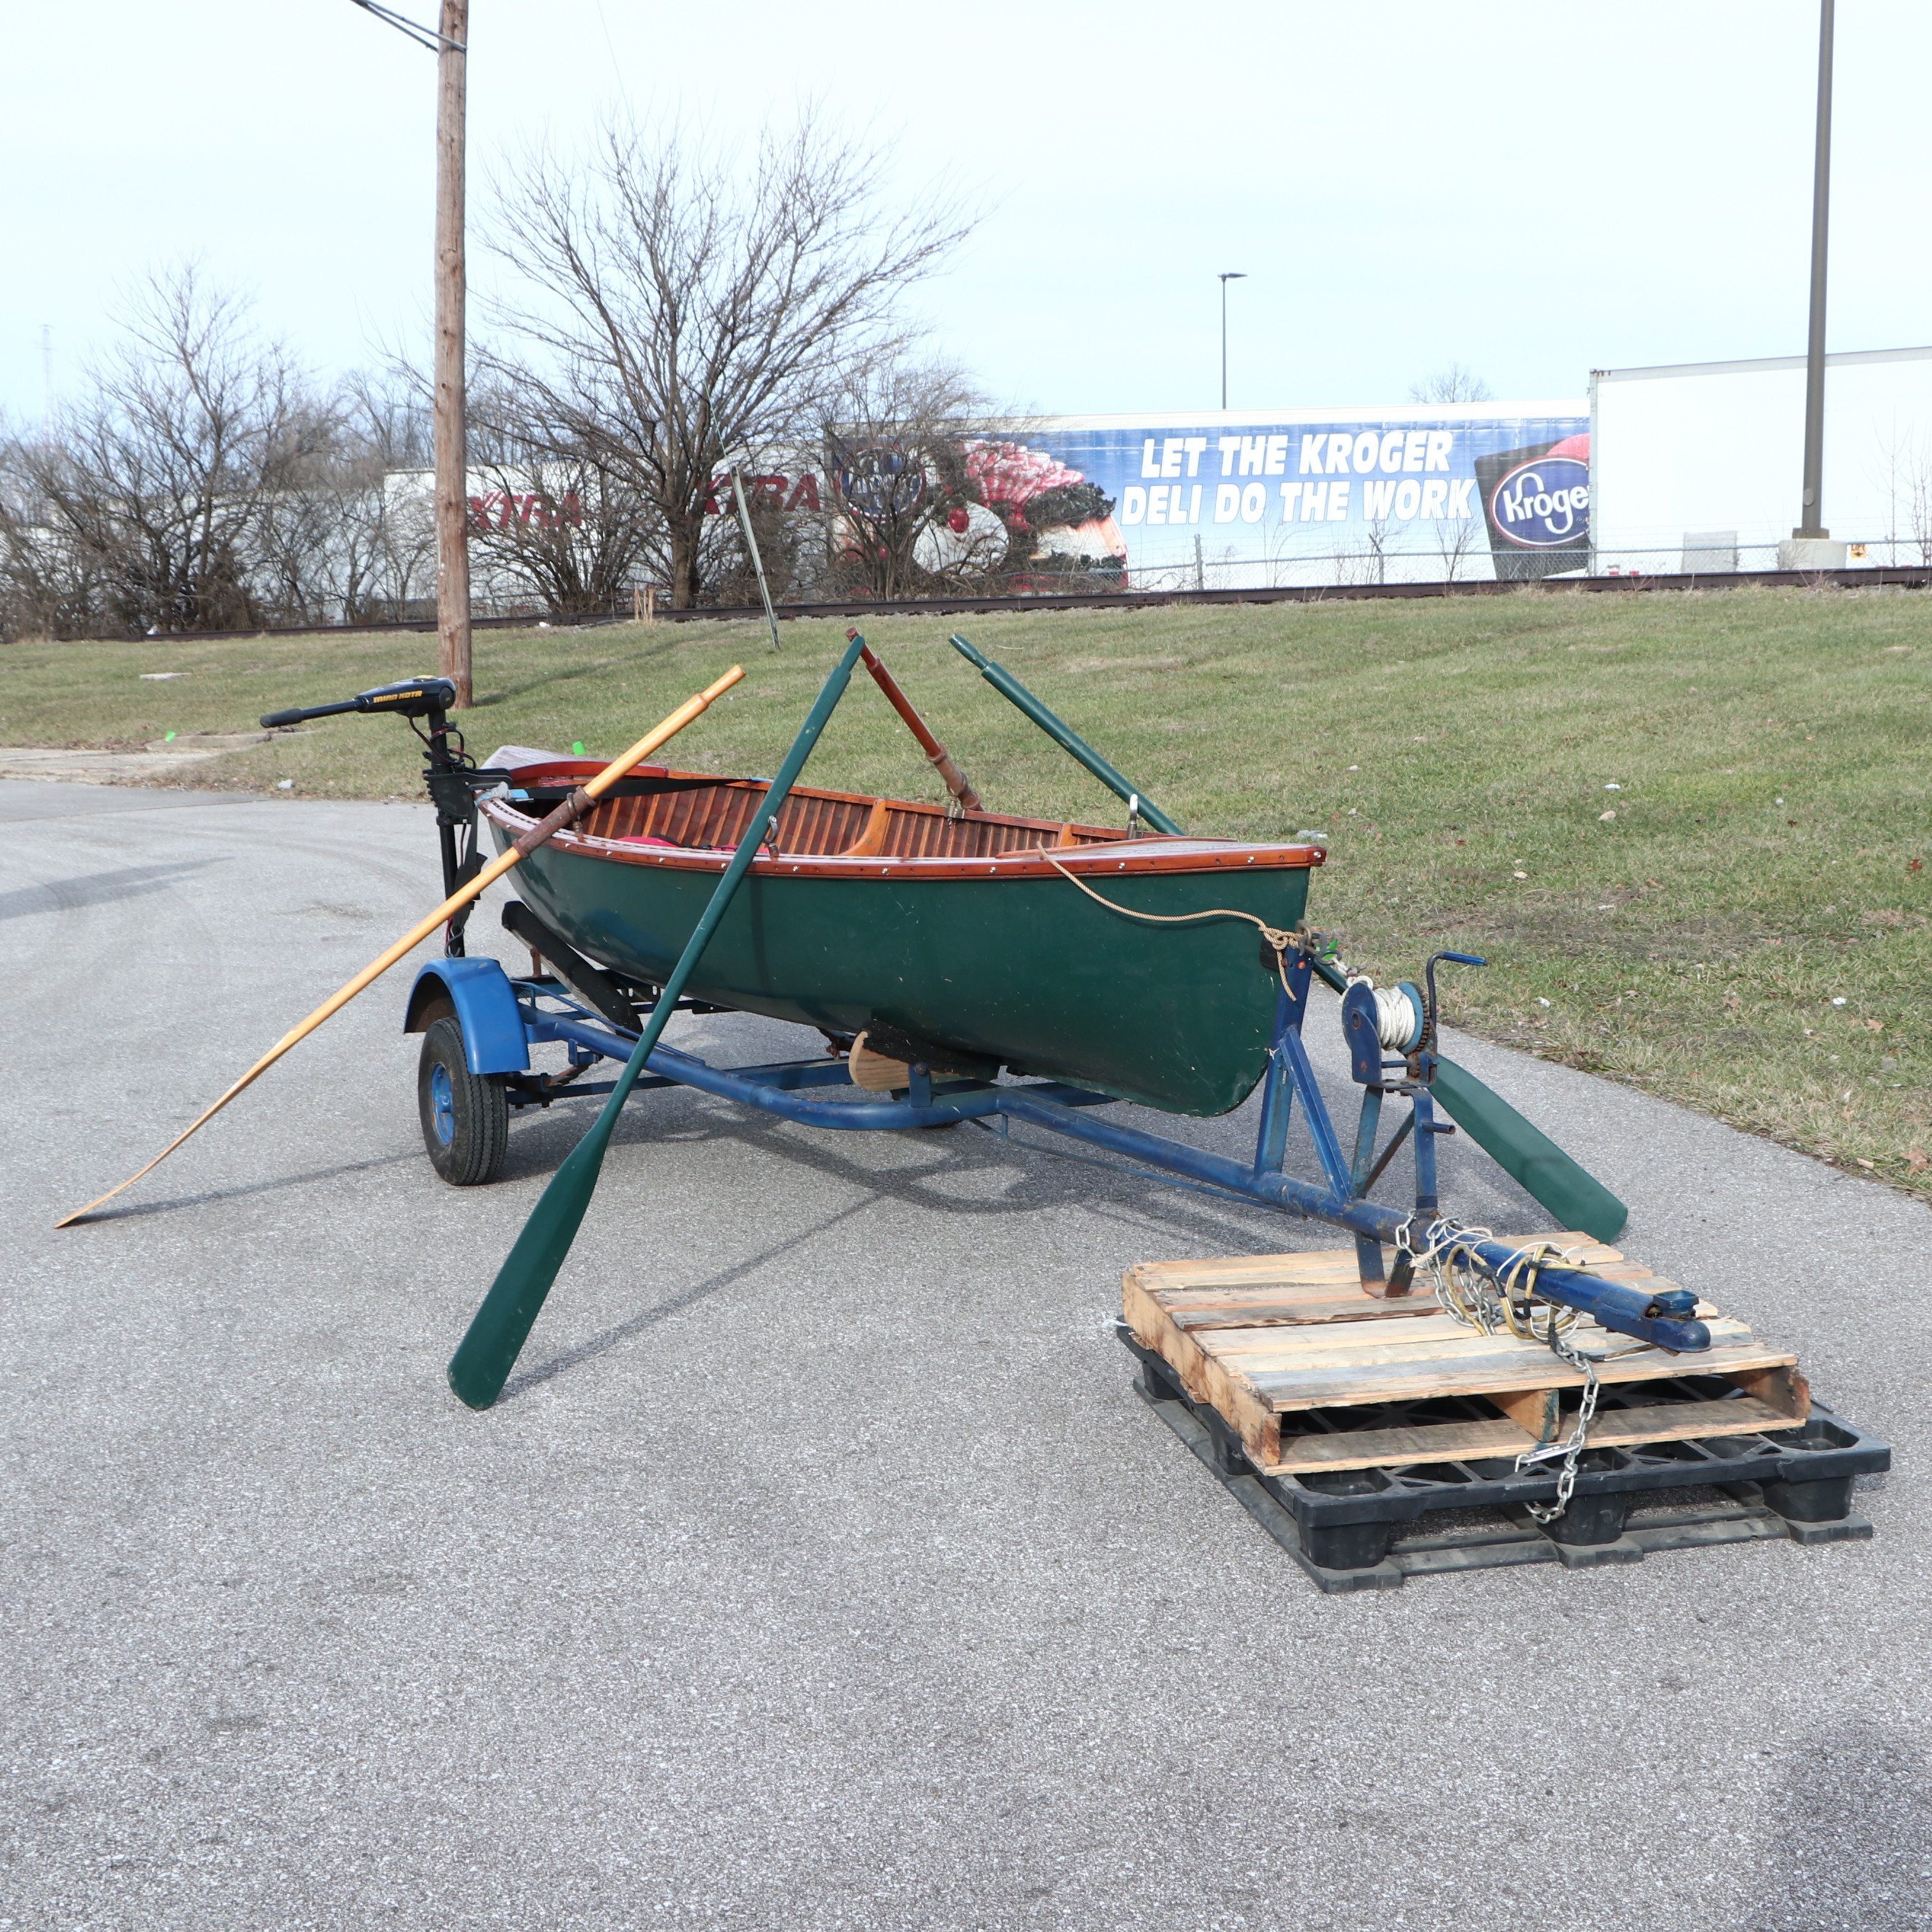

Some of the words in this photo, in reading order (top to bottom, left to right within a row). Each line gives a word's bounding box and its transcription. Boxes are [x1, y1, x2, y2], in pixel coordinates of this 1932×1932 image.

[1141, 437, 1208, 479] LET
[1218, 434, 1289, 476] THE
[1298, 431, 1453, 475] KROGER
[1120, 484, 1203, 526] DELI
[1213, 482, 1267, 524] DO
[1280, 481, 1351, 522] THE
[1362, 478, 1477, 522] WORK
[1503, 473, 1590, 534] Kroge
